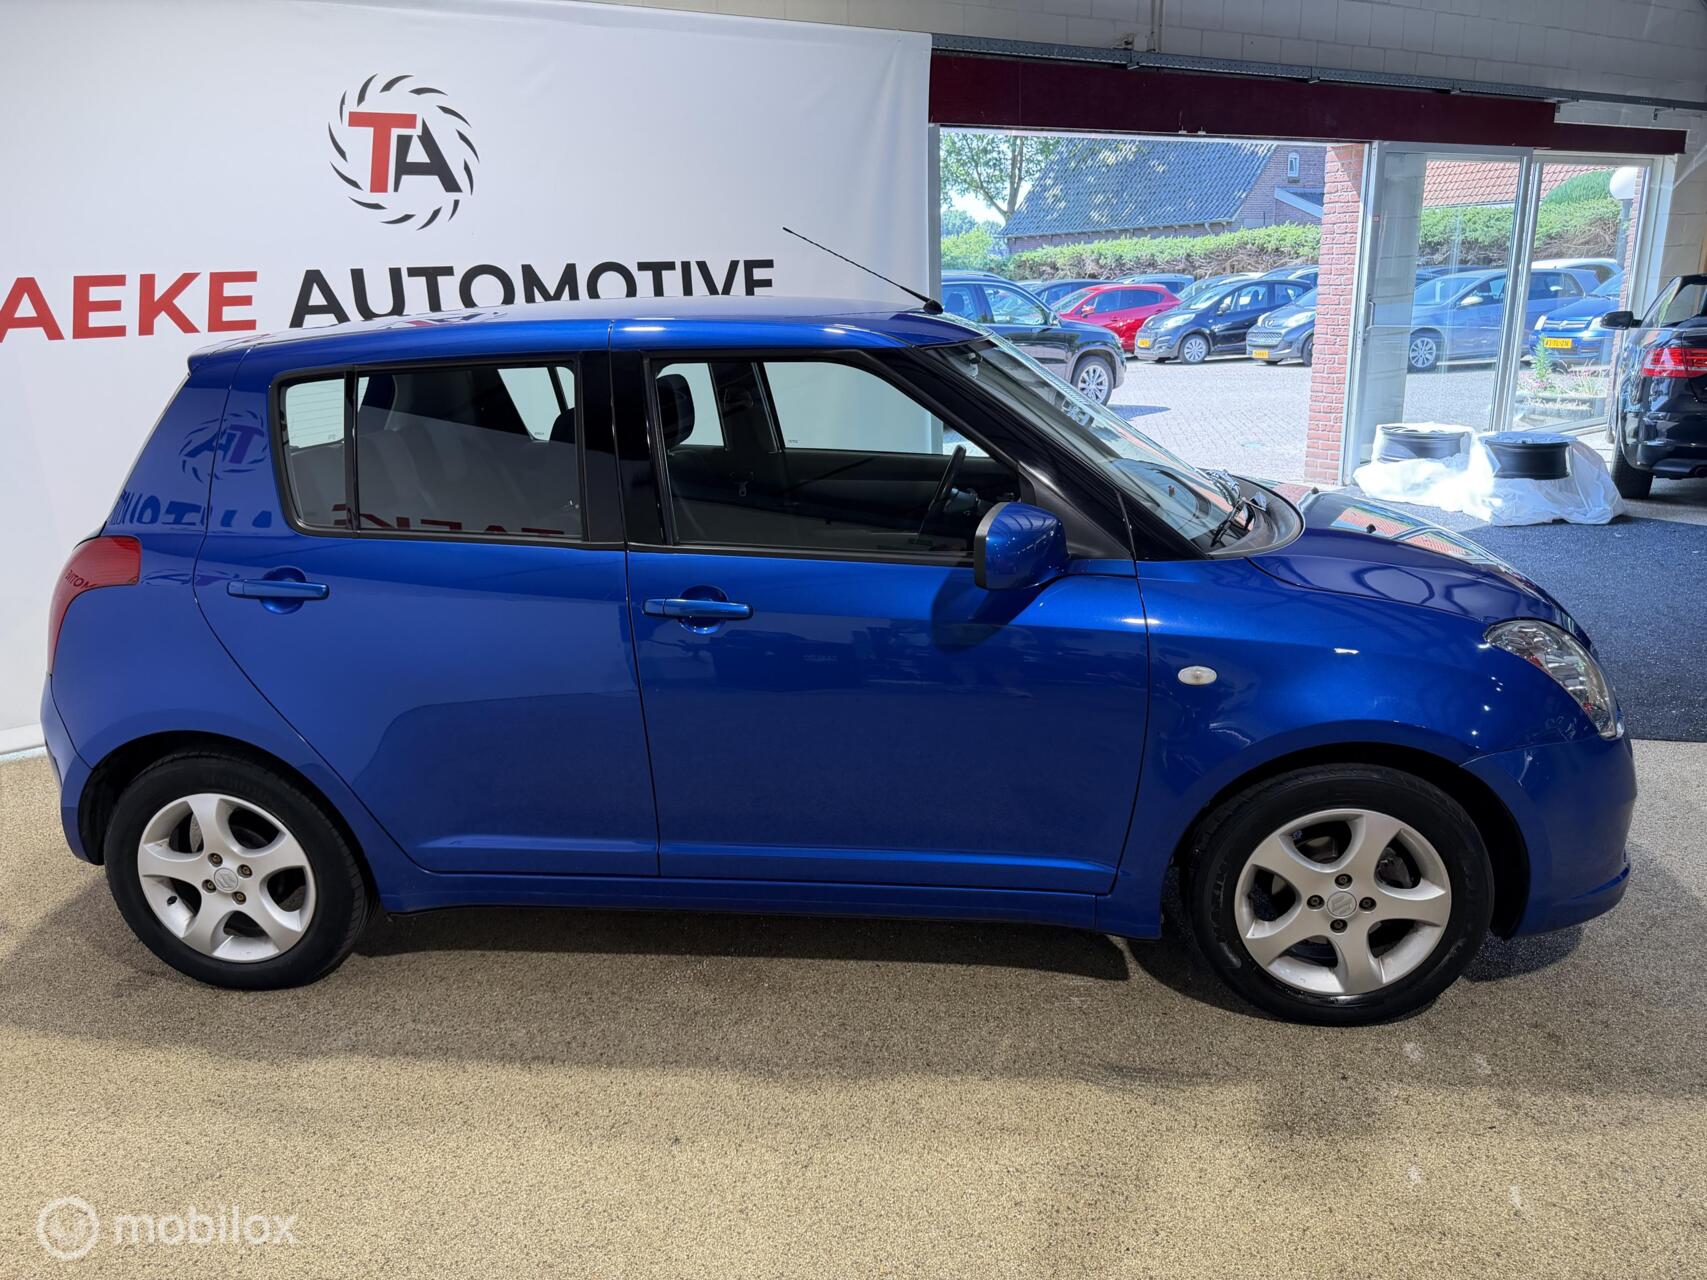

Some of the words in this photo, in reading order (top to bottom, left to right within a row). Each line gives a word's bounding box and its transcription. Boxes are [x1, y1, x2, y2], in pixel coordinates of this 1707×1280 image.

[348, 111, 463, 193] TA
[0, 271, 258, 343] AEKE
[289, 259, 775, 329] AUTOMOTIVE
